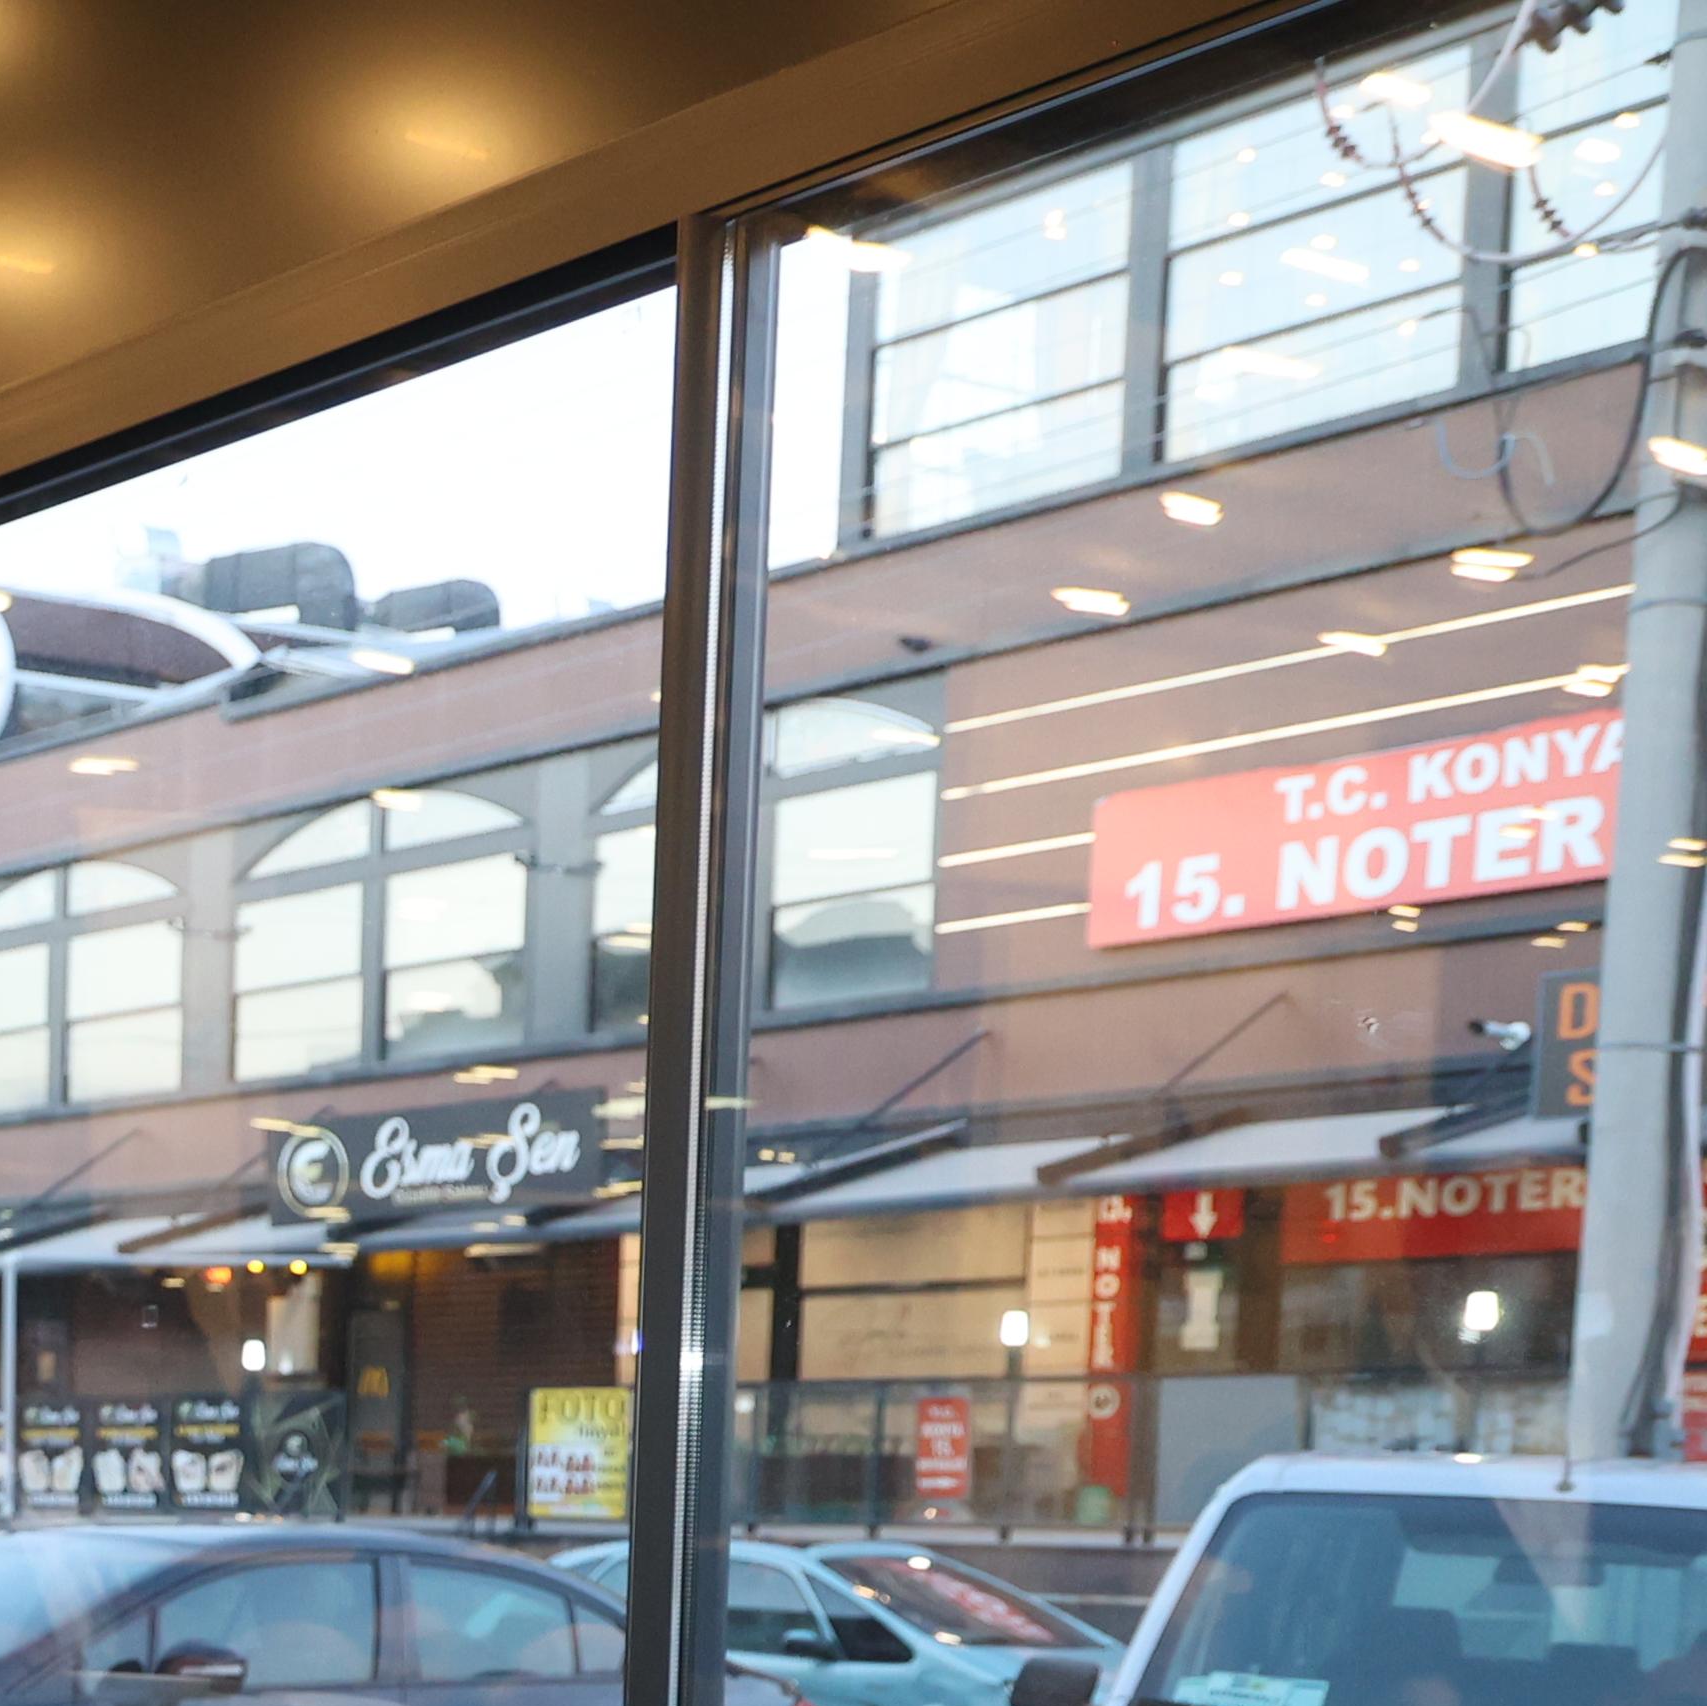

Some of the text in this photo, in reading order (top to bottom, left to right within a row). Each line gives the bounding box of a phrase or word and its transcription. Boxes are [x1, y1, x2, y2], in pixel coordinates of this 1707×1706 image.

[1274, 719, 1623, 822] T.C. KONYA
[1124, 796, 1605, 928] 15. NOTER
[360, 1116, 475, 1200] Esma
